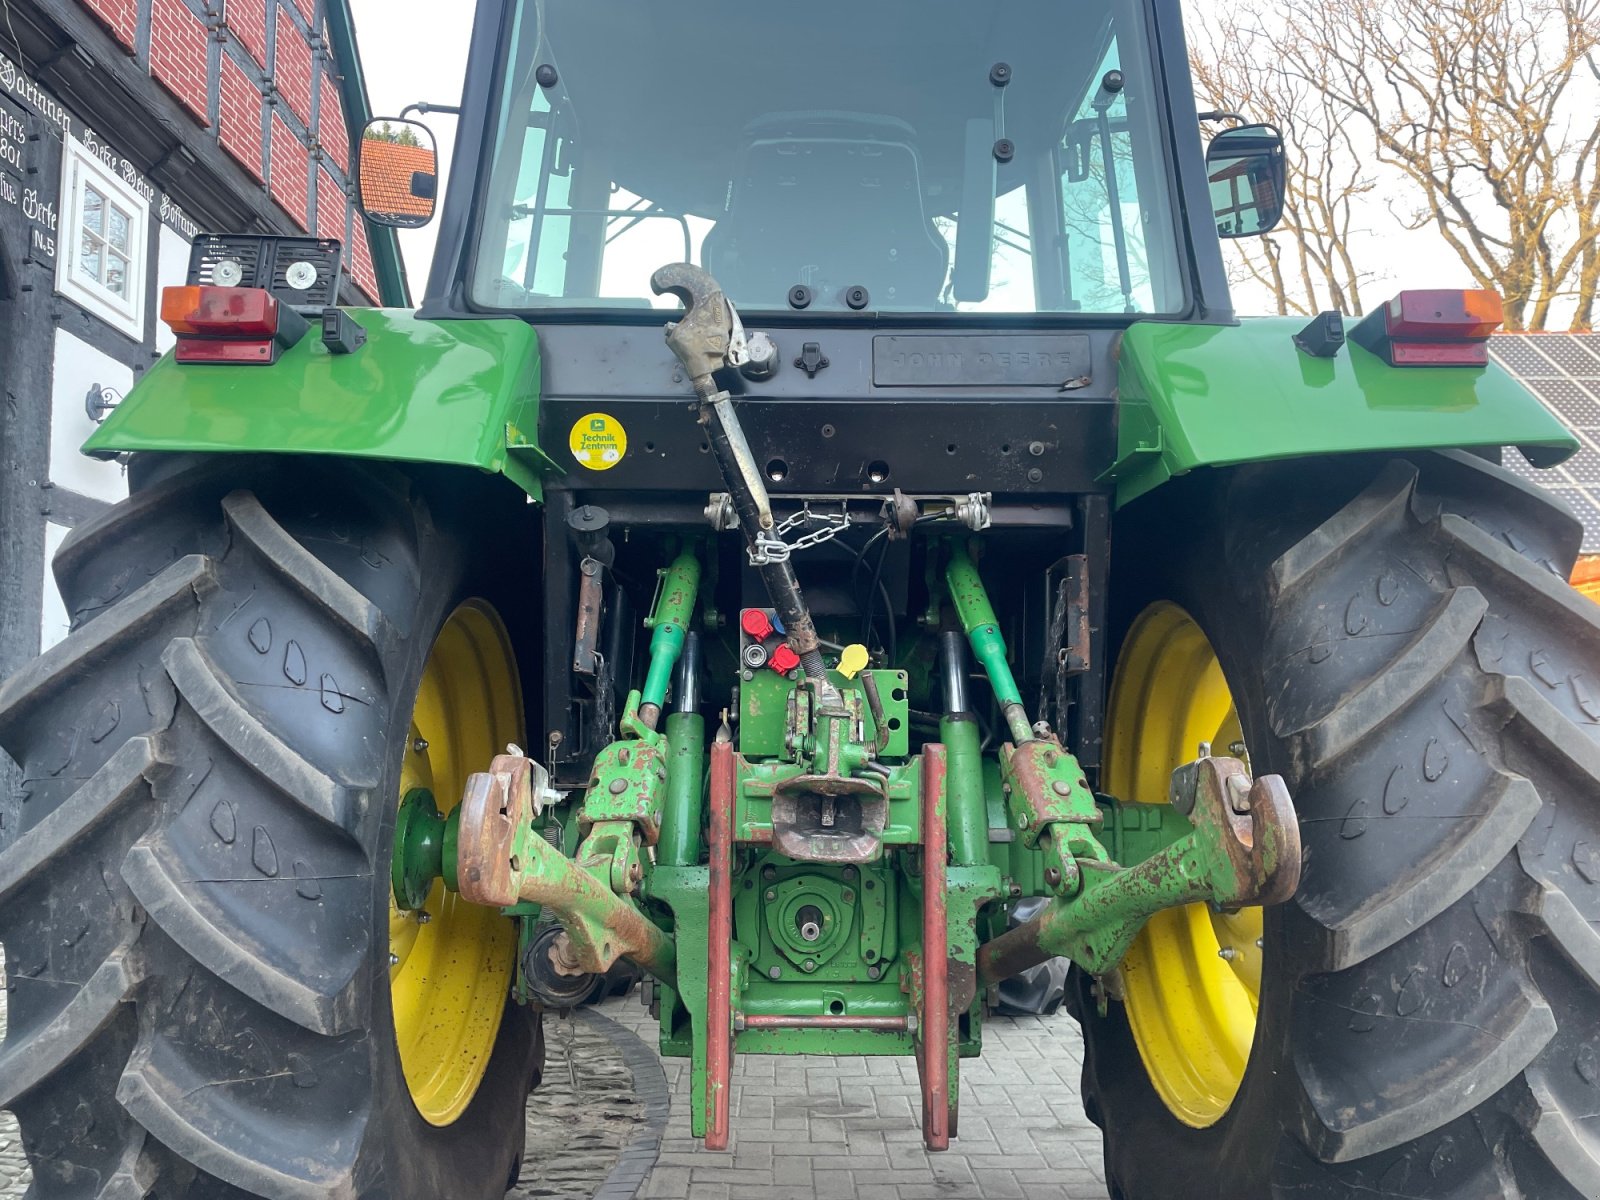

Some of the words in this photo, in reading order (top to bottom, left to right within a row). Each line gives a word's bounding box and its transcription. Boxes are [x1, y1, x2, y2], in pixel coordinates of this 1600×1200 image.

[160, 193, 202, 238] Hoffnun
[893, 351, 963, 368] JOHN
[977, 351, 1072, 367] DEERE
[582, 434, 615, 442] Technik
[580, 442, 618, 450] Zentrum
